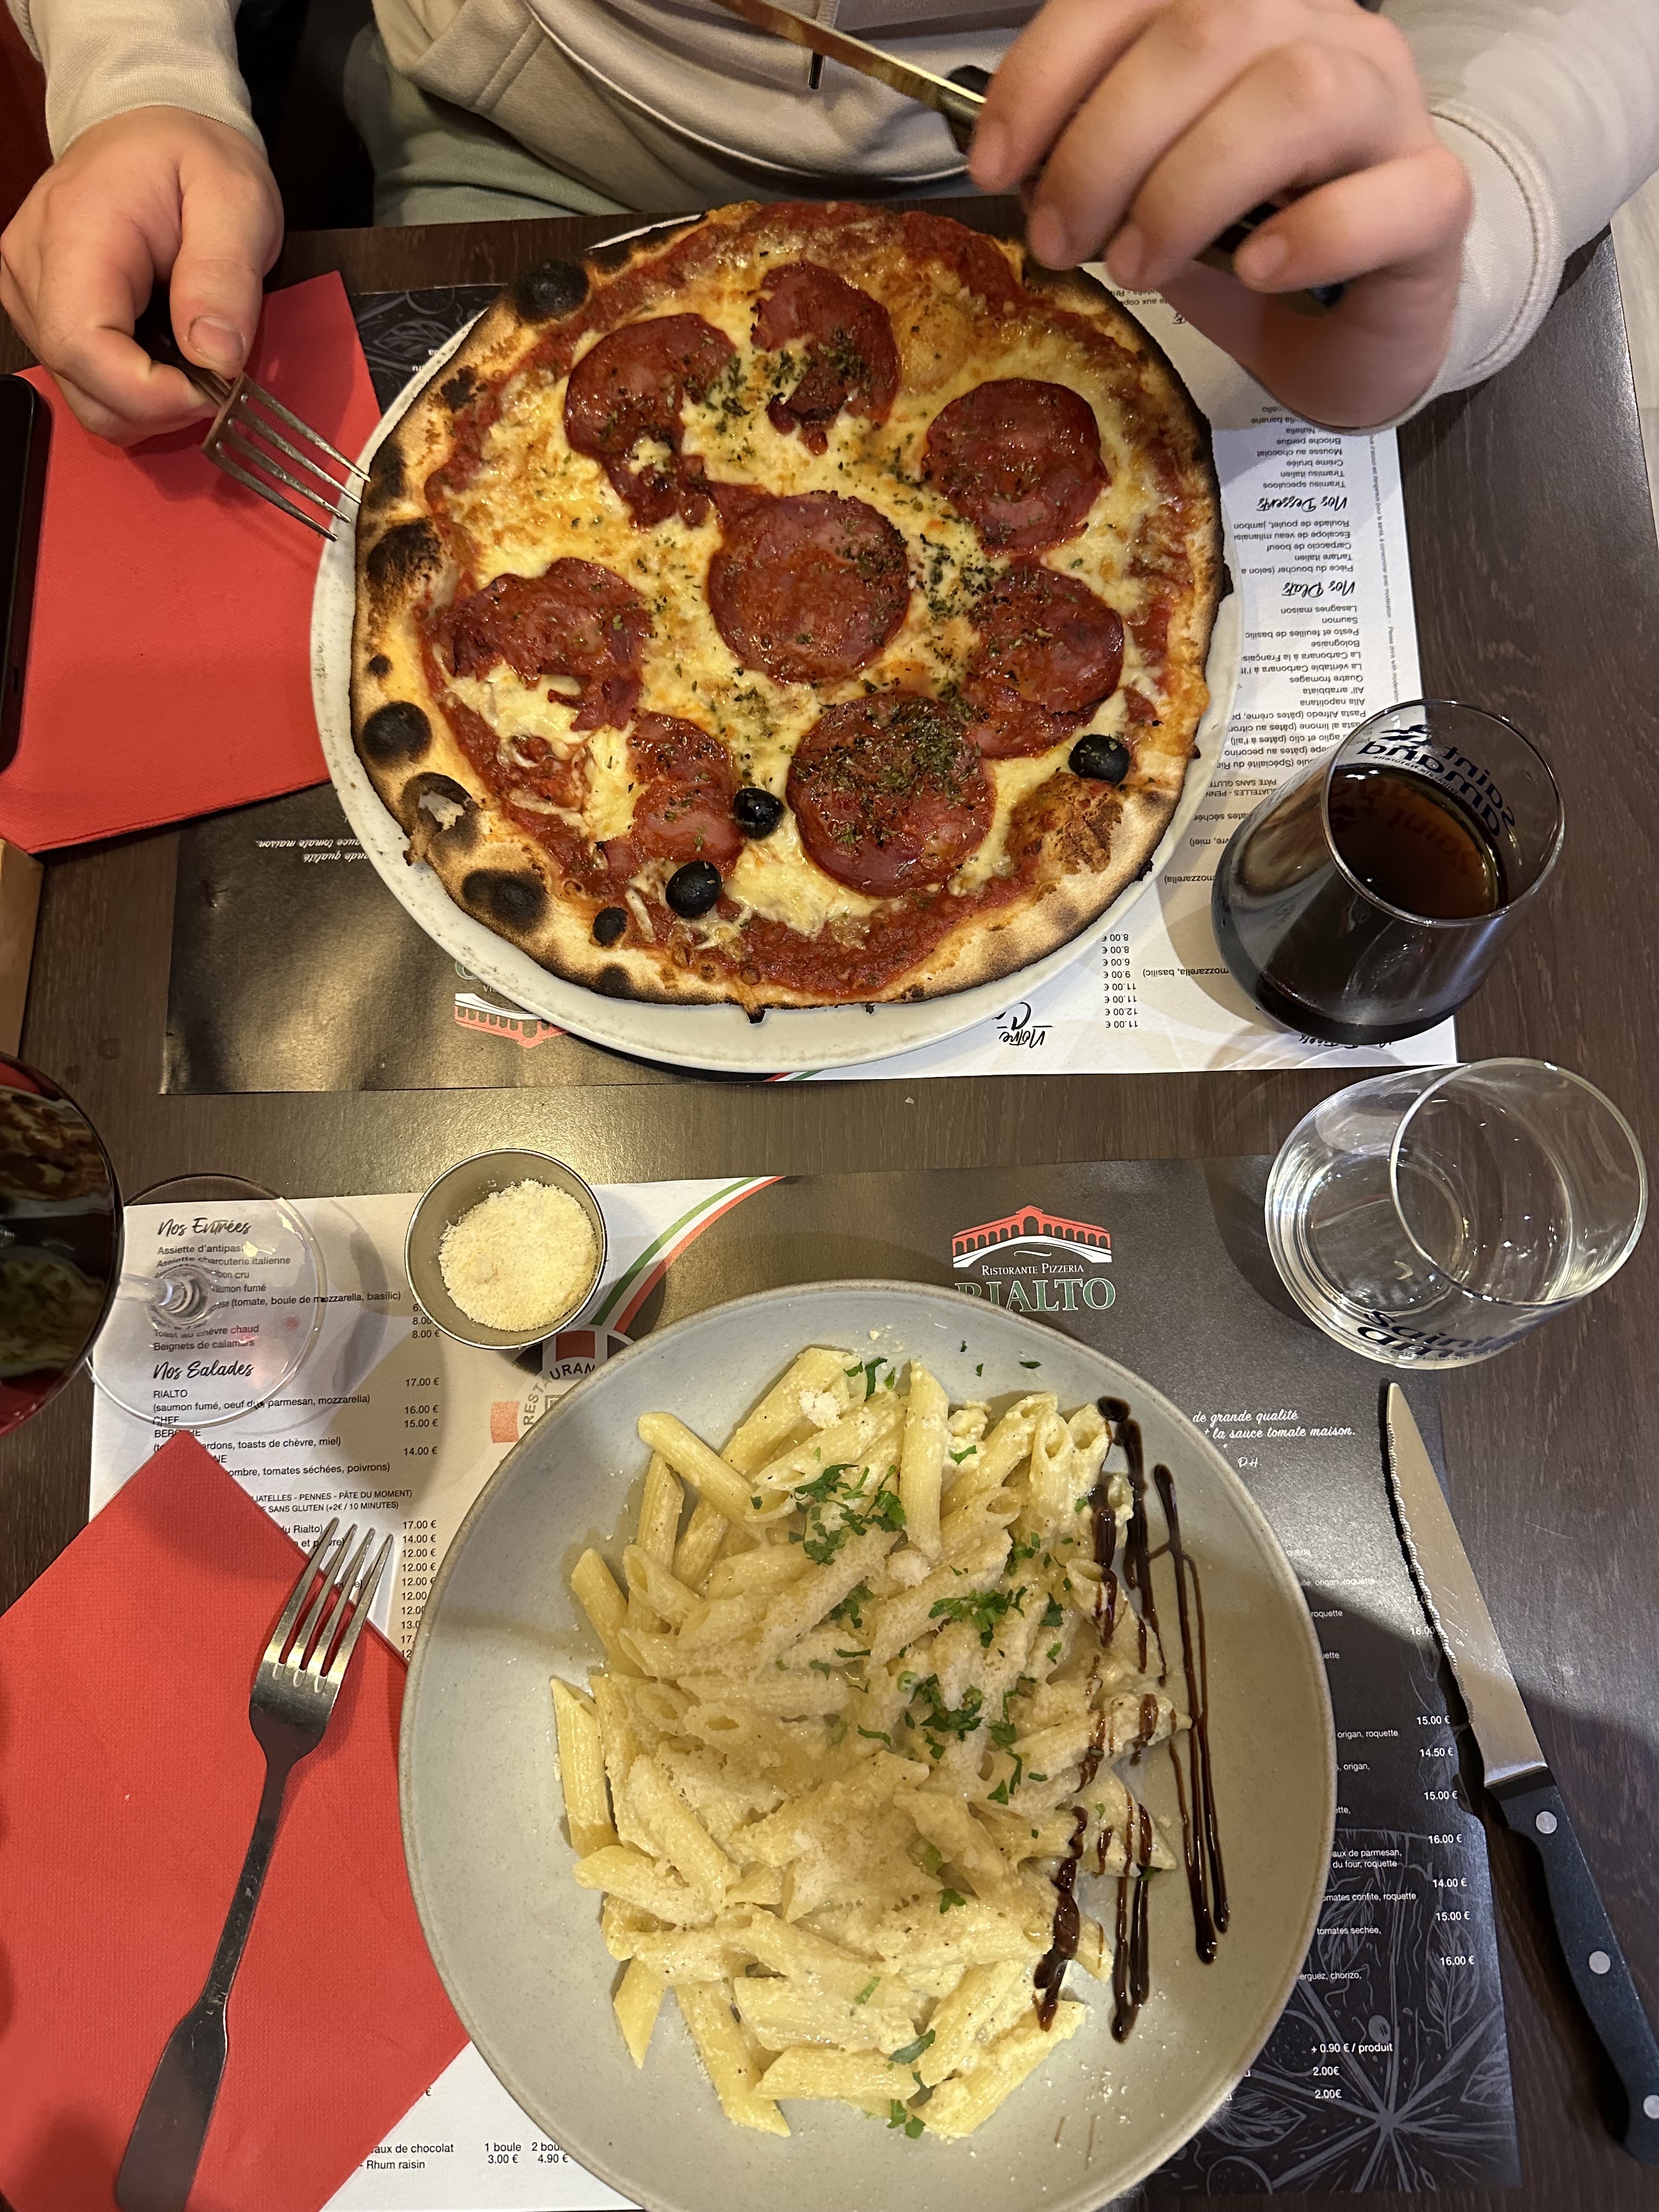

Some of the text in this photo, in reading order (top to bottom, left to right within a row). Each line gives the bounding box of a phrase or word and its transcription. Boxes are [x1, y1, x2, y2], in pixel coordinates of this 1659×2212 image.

[1263, 481, 1306, 489] speculoos
[1257, 496, 1347, 512] Nos Desserts
[1234, 521, 1266, 530] jambon
[1268, 520, 1297, 529] poulet,
[1307, 541, 1351, 550] Carpaccio
[1249, 567, 1274, 575] (selon
[1282, 580, 1355, 597] Nos Plats
[1311, 639, 1359, 647] Bolognaise
[1300, 698, 1346, 706] napolitana
[1277, 711, 1304, 719] (pâtes
[1269, 723, 1296, 731] (pâtes
[1259, 735, 1286, 744] (pâtes
[1319, 733, 1340, 742] aglio
[1224, 746, 1307, 757] (pâtes pecorino
[1248, 759, 1294, 769] (Spécialité
[299, 840, 333, 848] tomate
[1190, 838, 1210, 847] miel)
[304, 850, 341, 863] qualité
[1164, 876, 1213, 884] mozzarella)
[1143, 968, 1229, 978] mozzarella, basilic)
[999, 1029, 1045, 1048] Notre
[158, 1217, 251, 1237] Nos Entrées
[158, 1246, 195, 1254] Assiette
[198, 1257, 249, 1265] charcuterie
[244, 1283, 266, 1292] fumé
[232, 1298, 268, 1308] (tomate,
[271, 1296, 296, 1305] boule
[368, 1291, 400, 1301] basilic)
[197, 1324, 259, 1336] chèvre chaud
[152, 1342, 194, 1352] Beignets
[154, 1360, 254, 1380] Nos Salades
[154, 1390, 188, 1398] RIALTO
[154, 1404, 192, 1413] (saumon
[195, 1402, 221, 1410] fumé,
[224, 1400, 244, 1409] oeuf
[268, 1398, 315, 1407] parmesan,
[318, 1395, 370, 1404] mozzarella)
[1193, 1409, 1298, 1428] de grande qualité
[1229, 1426, 1355, 1438] sauce tomate maison.
[319, 1437, 340, 1446] miel)
[303, 1465, 343, 1474] séchées,
[347, 1463, 390, 1474] poivrons)
[339, 1491, 358, 1499] PÂTE
[294, 1524, 323, 1534] Rialto)
[1417, 1716, 1441, 1724] 15.00
[1366, 1730, 1398, 1738] roquette
[1420, 1747, 1453, 1757] 14.50 €
[1424, 1791, 1449, 1800] 15.00
[1429, 1834, 1462, 1843] 16.00 €
[1364, 1860, 1397, 1869] roquette
[1433, 1878, 1466, 1887] 14.00 €
[1352, 1893, 1416, 1901] confite, roquette
[1436, 1911, 1470, 1921] 15.00 €
[1441, 1955, 1474, 1966] 16.00 €
[1320, 2044, 1340, 2052] 0.90
[1358, 2042, 1392, 2054] produit
[1313, 2067, 1339, 2075] 2.00€
[1315, 2089, 1341, 2098] 2.00€
[396, 2145, 408, 2153] de
[411, 2143, 453, 2153] chocolat
[494, 2142, 521, 2151] boule
[488, 2154, 518, 2163] 3.00 €
[538, 2154, 558, 2163] 4.90
[367, 2160, 425, 2169] Rhum raisin
